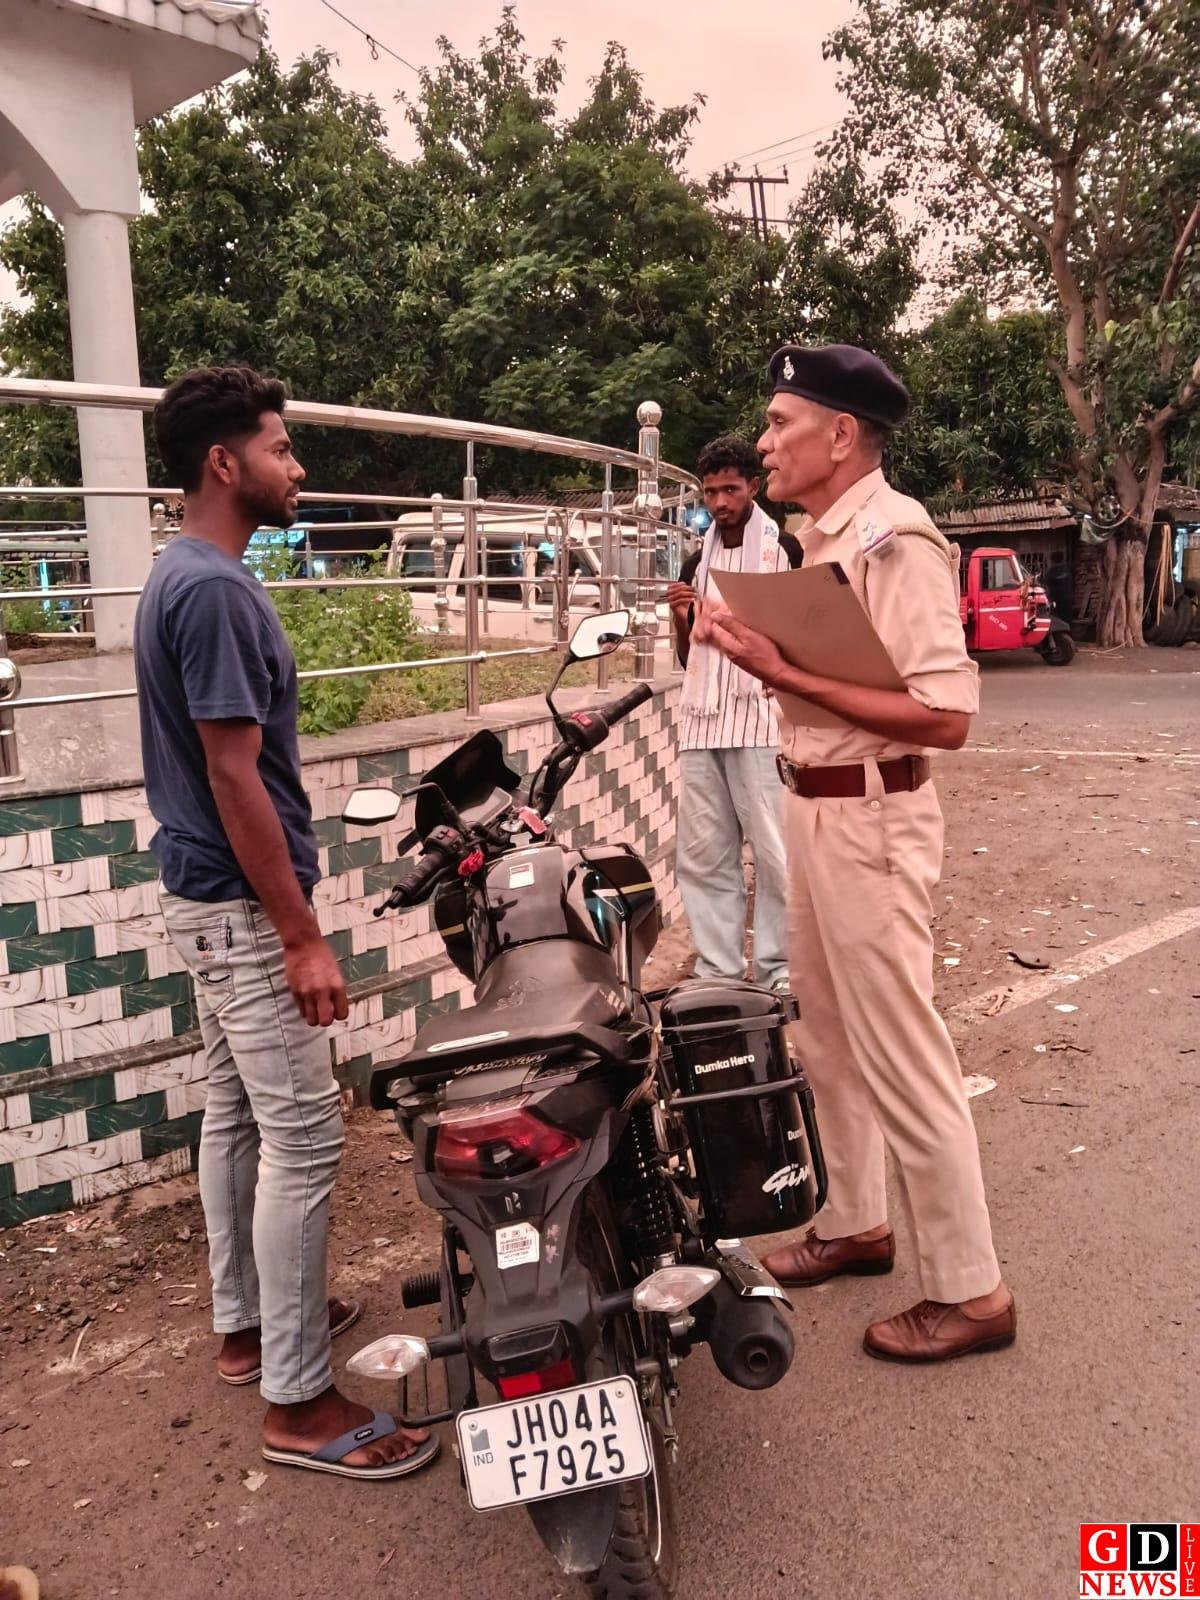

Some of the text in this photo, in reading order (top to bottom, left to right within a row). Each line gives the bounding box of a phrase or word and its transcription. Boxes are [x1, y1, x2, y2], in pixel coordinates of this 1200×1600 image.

[730, 1054, 755, 1067] Hero
[506, 1388, 617, 1448] JH04A
[473, 1452, 494, 1466] IND
[509, 1433, 625, 1495] F7925
